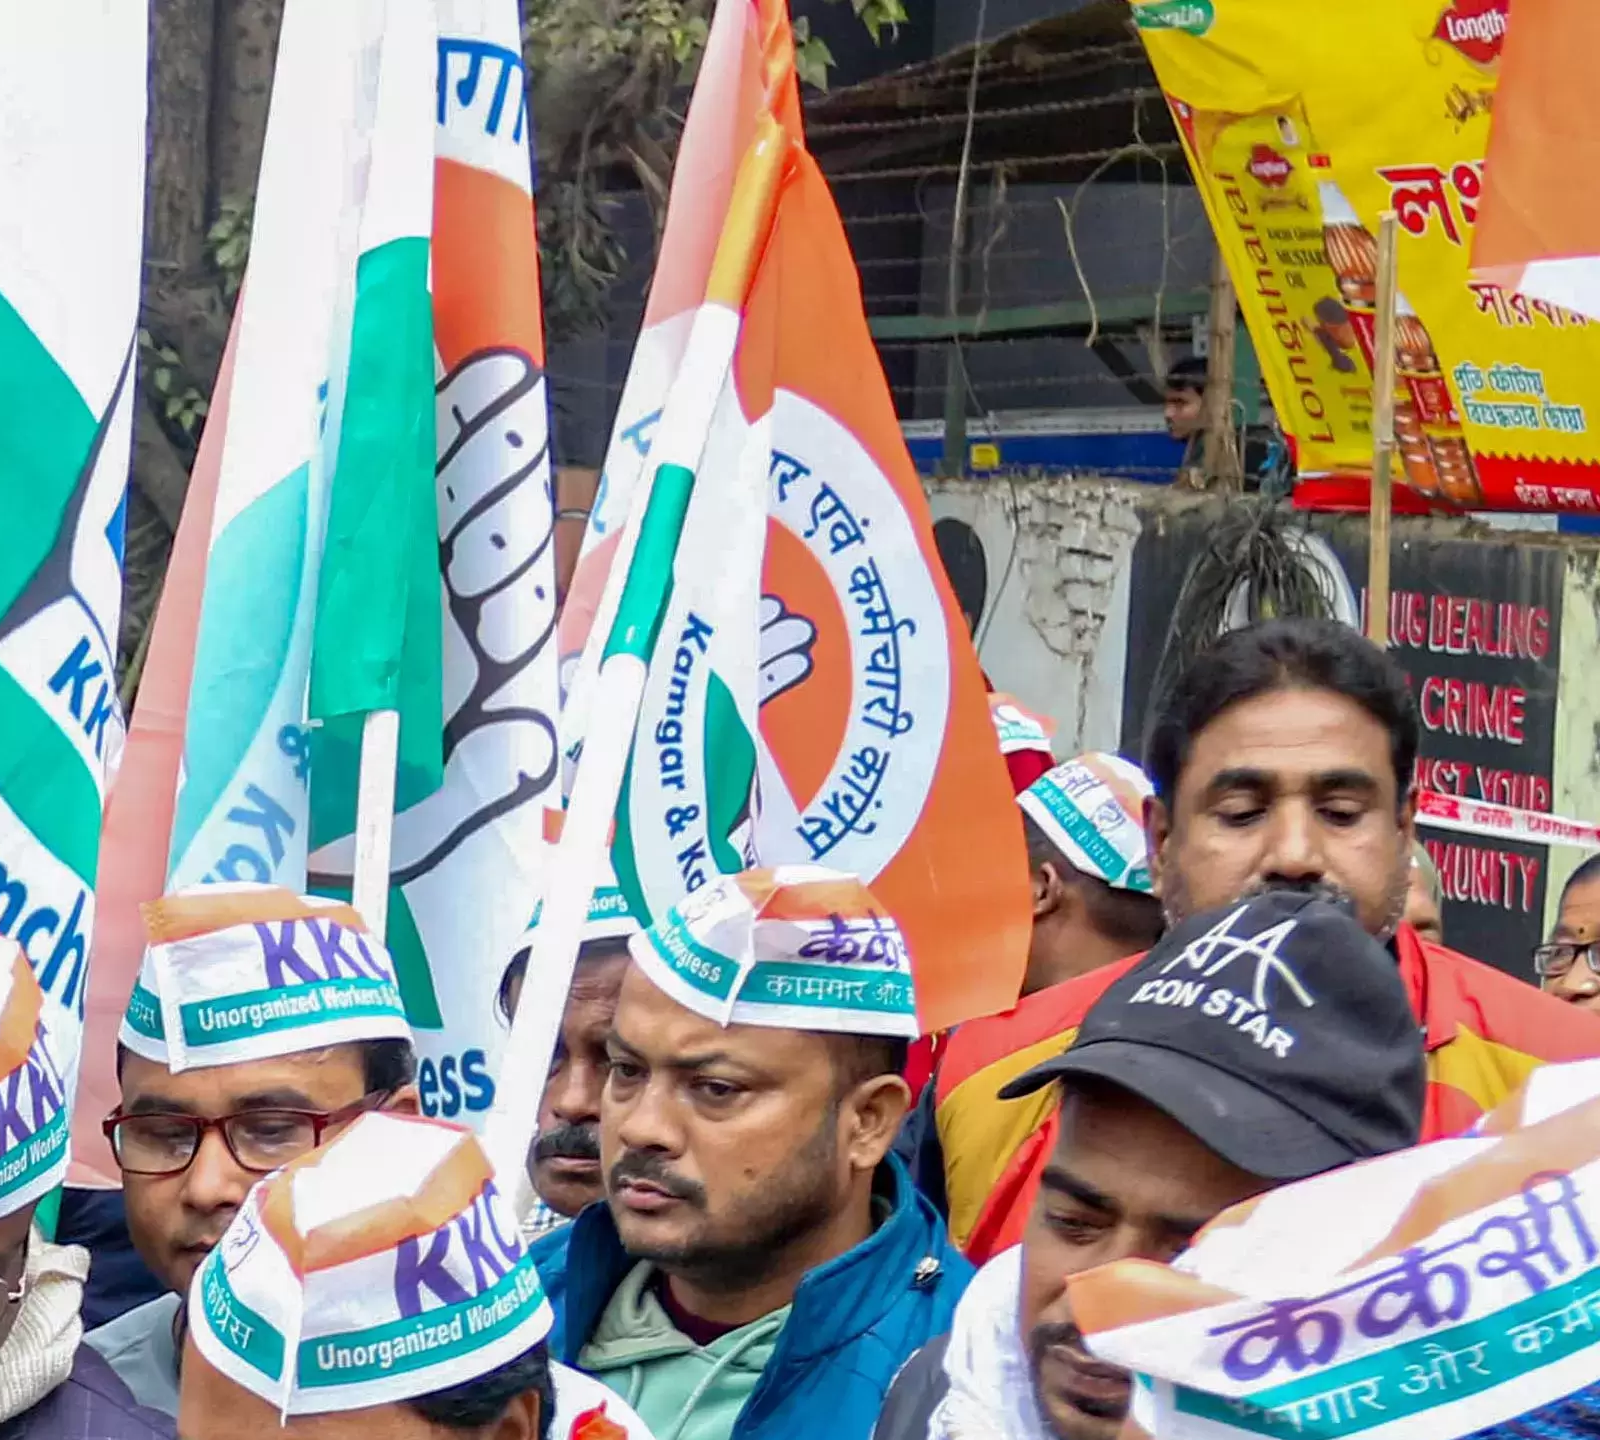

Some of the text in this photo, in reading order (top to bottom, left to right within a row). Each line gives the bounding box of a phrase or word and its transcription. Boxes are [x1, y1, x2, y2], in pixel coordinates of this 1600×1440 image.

[803, 481, 871, 555] एवं
[848, 556, 918, 740] कर्मचारी
[1429, 592, 1550, 661] DEALING
[47, 634, 113, 760] KK
[1421, 676, 1528, 745] CRIME
[655, 611, 714, 894] Kamgar & Ka
[795, 746, 892, 862] कांग्रेस
[198, 991, 321, 1032] Unorganized
[1128, 978, 1295, 1058] ICON STAR
[394, 1178, 522, 1319] KKC
[316, 1313, 464, 1372] Unorganized
[1399, 1340, 1493, 1396] और
